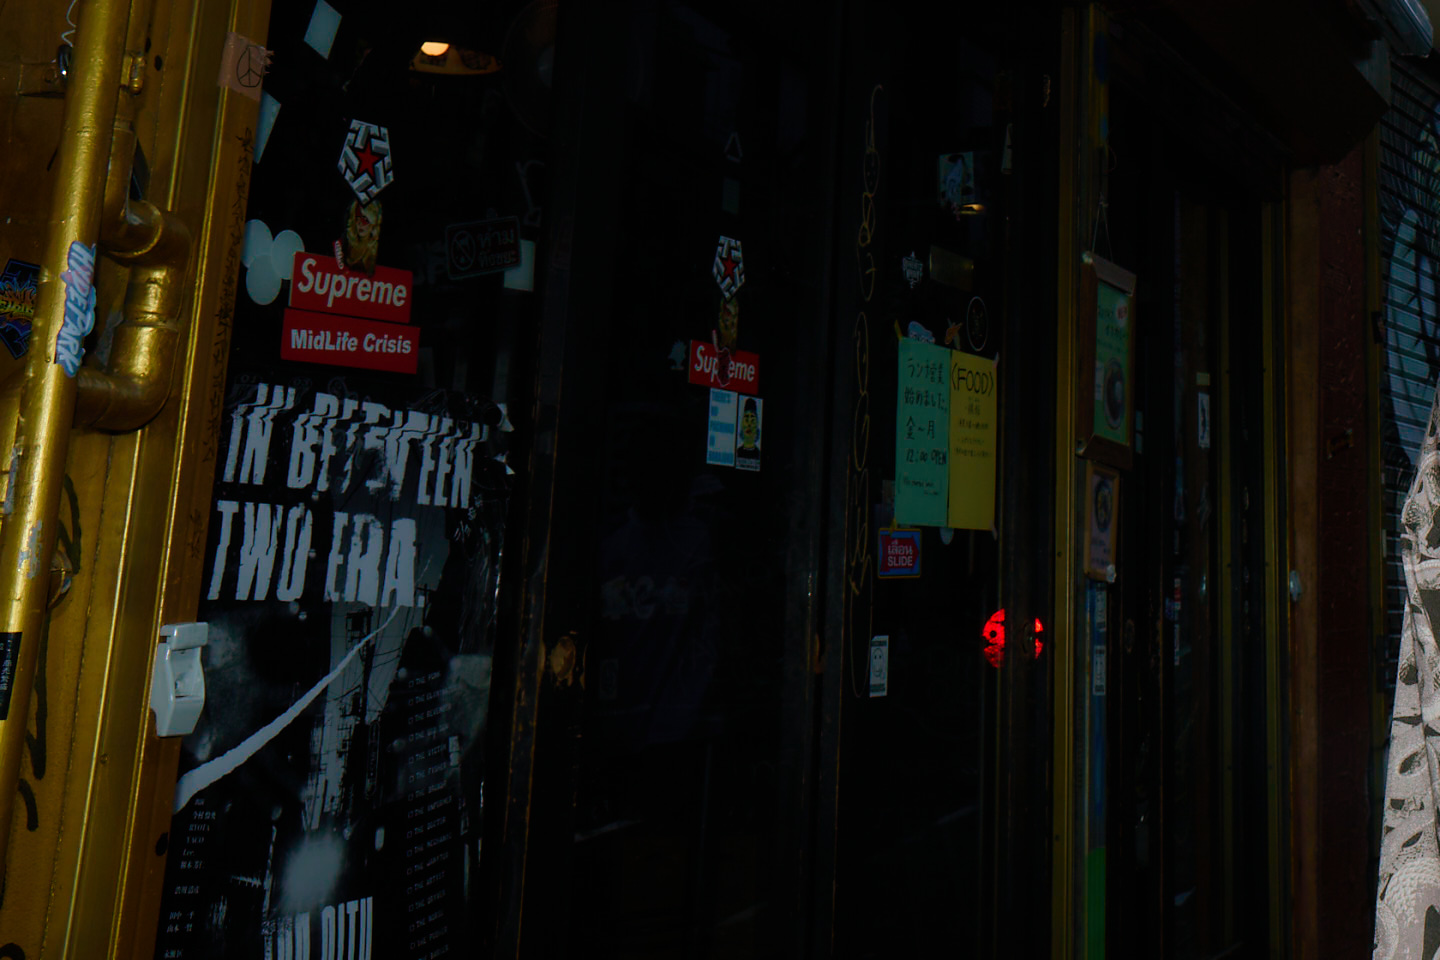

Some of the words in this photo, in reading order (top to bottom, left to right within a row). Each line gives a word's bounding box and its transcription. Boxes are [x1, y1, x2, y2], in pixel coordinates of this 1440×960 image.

[297, 257, 408, 308] Supreme
[290, 328, 359, 353] MidLife
[362, 333, 412, 355] Crisis
[694, 344, 756, 384] Supeme
[222, 382, 297, 486] IN
[206, 499, 313, 602] TWO
[887, 555, 913, 567] SLIDE
